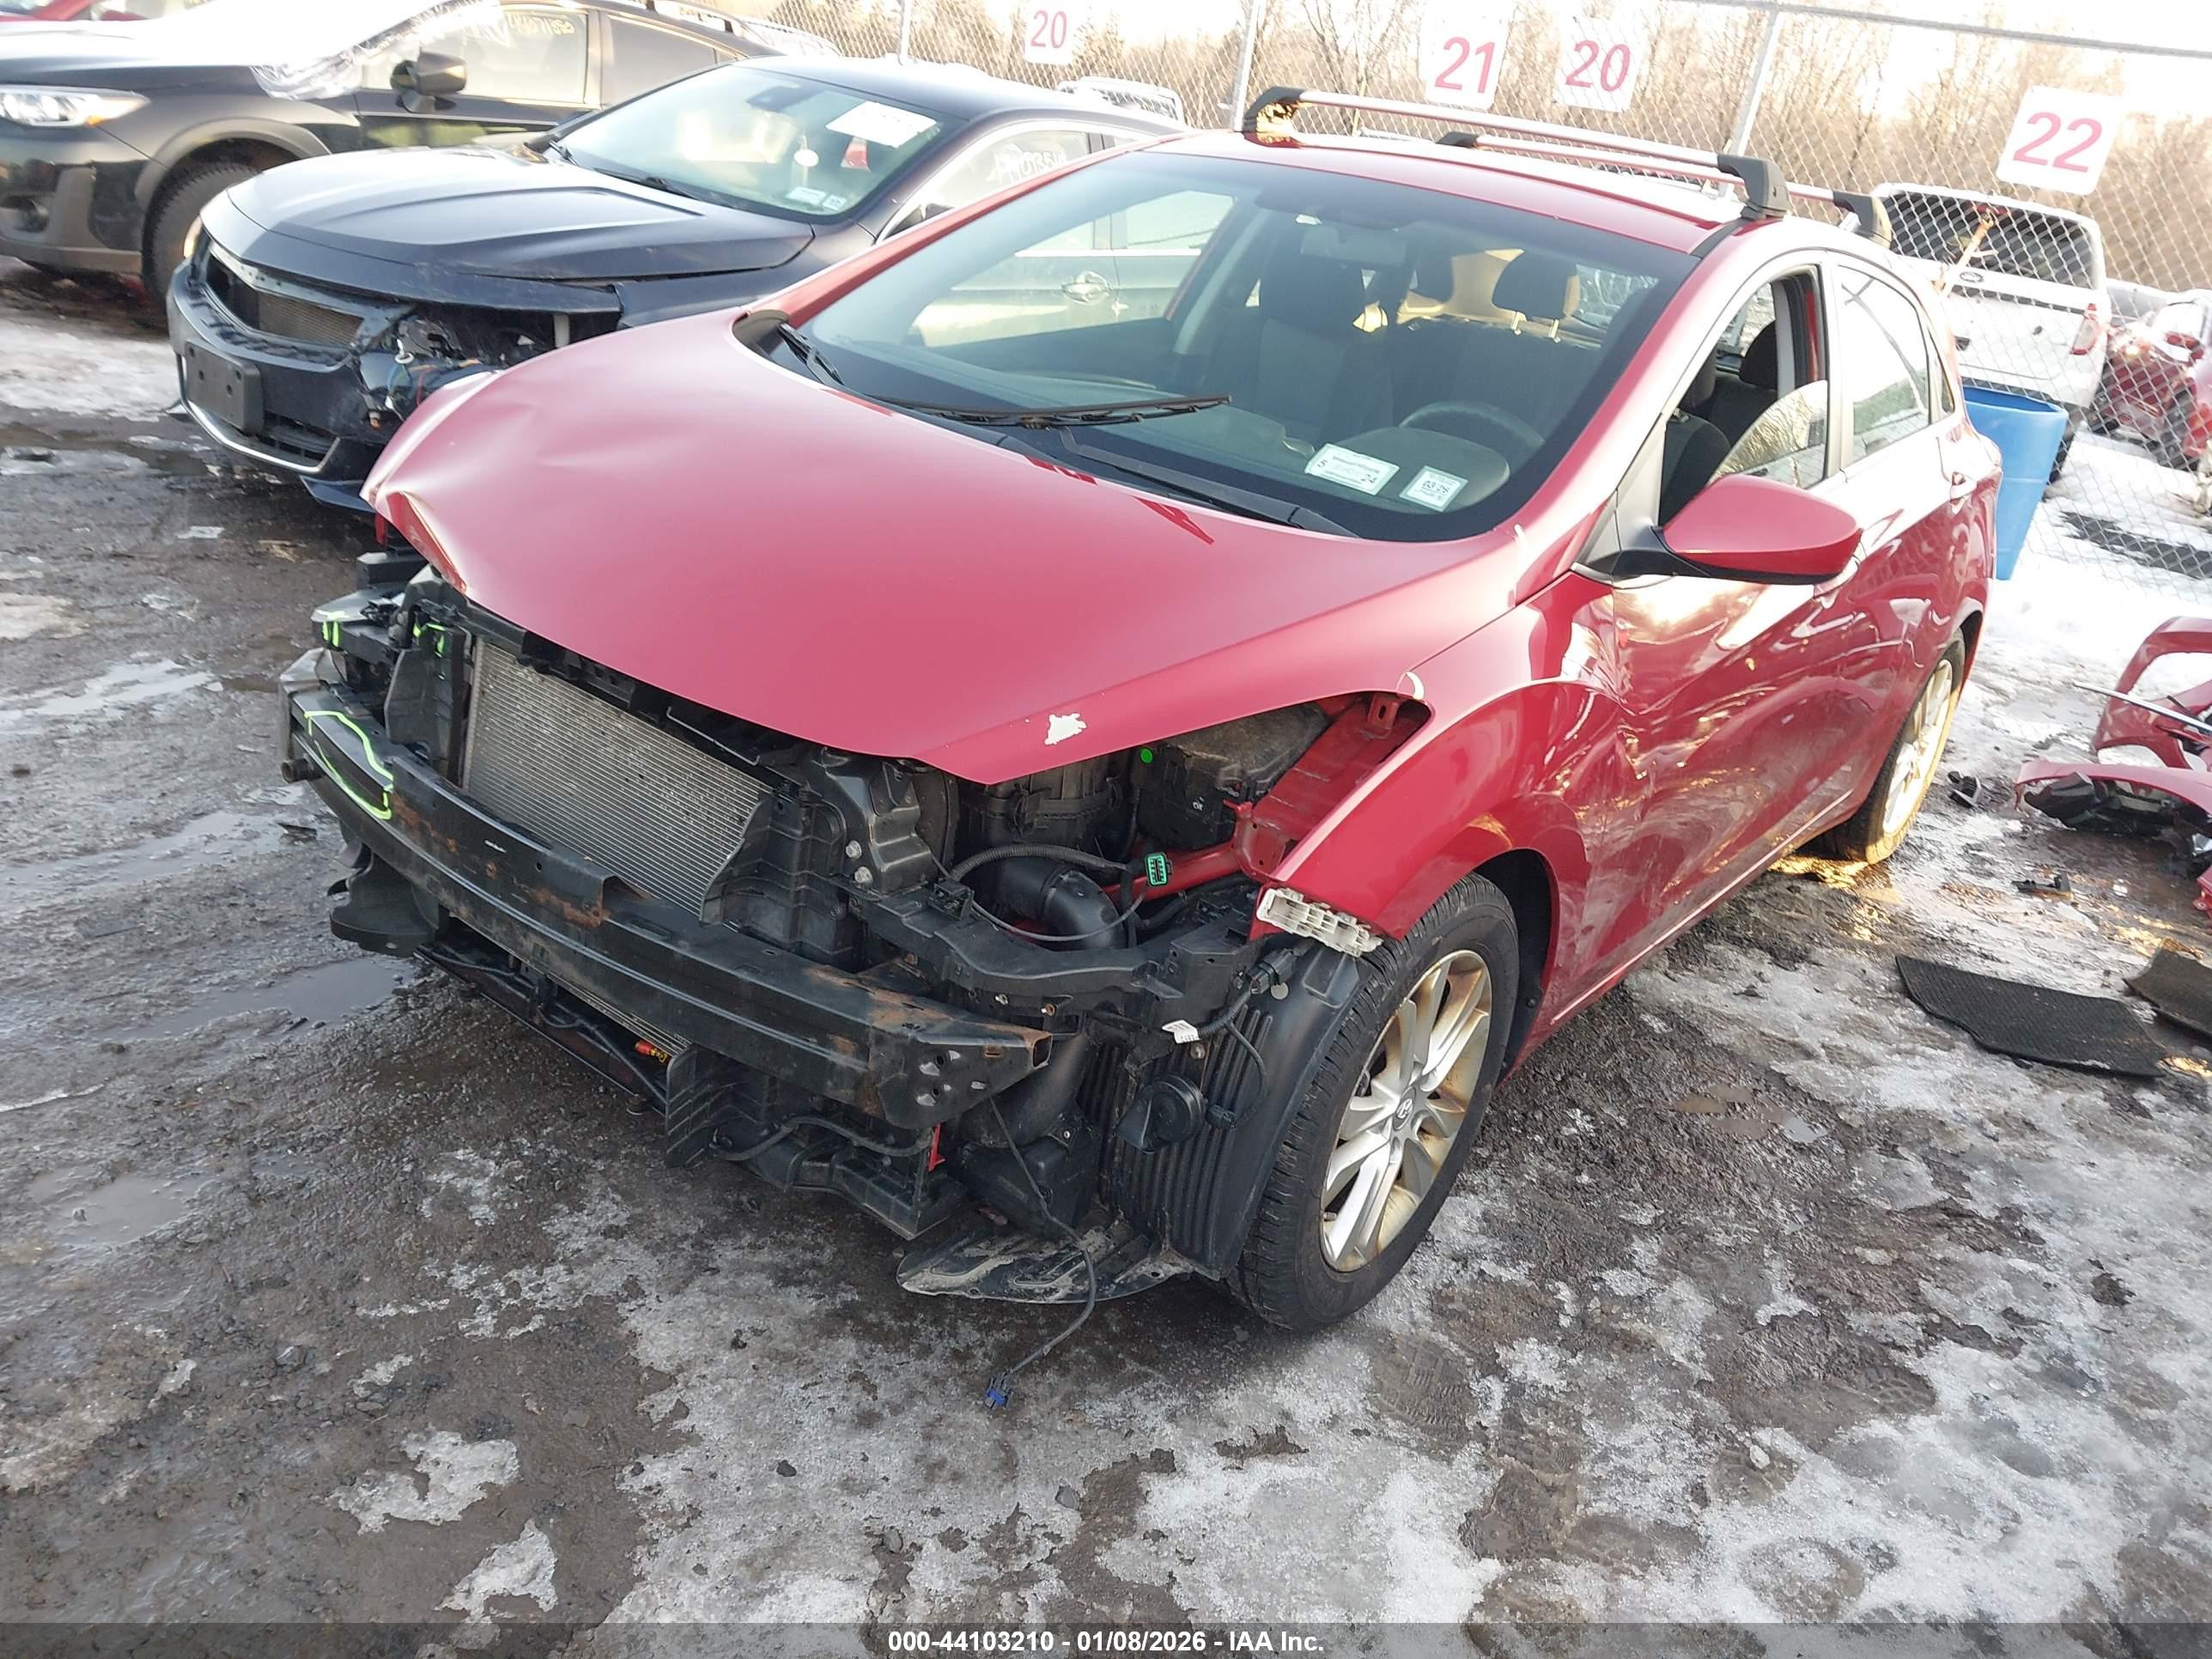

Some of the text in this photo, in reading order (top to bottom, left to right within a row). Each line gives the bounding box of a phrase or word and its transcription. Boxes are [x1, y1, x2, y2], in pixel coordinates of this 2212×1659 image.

[1030, 9, 1066, 49] 20
[1434, 36, 1496, 94] 21
[1565, 40, 1631, 93] 20
[2012, 111, 2103, 173] 22
